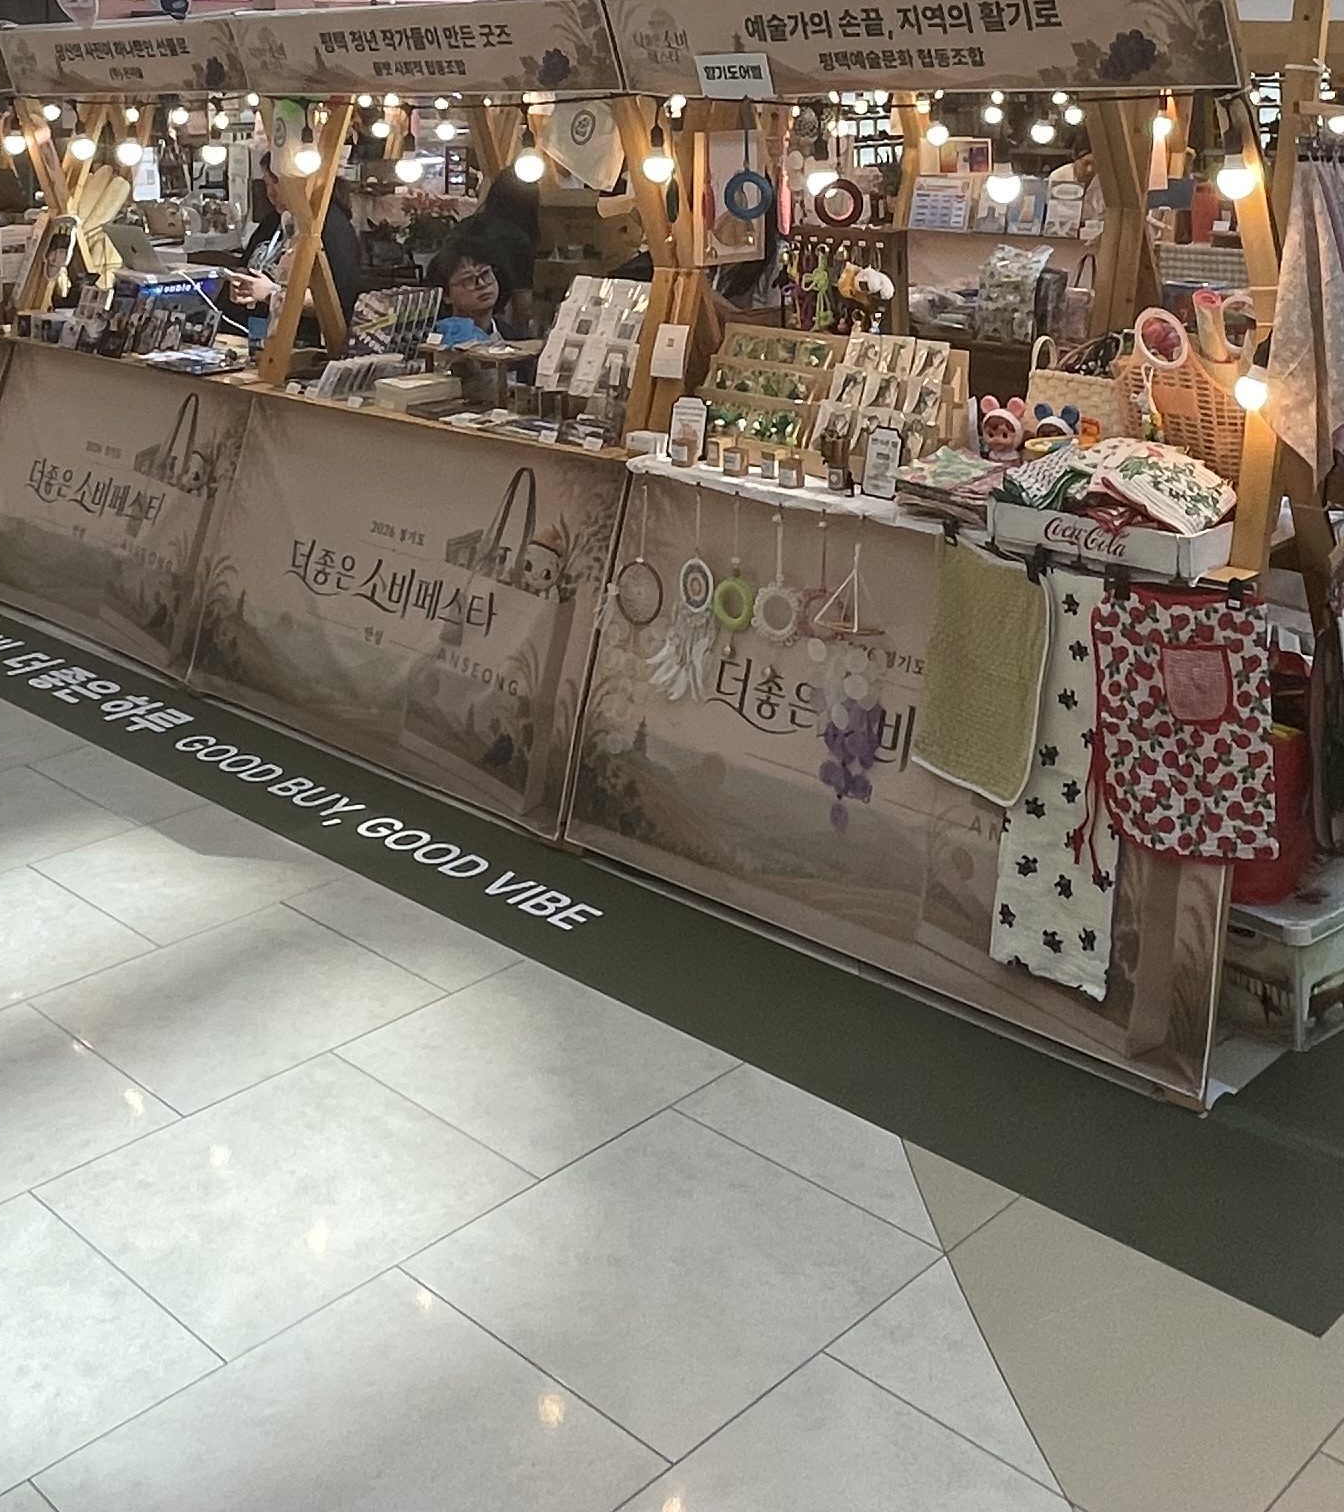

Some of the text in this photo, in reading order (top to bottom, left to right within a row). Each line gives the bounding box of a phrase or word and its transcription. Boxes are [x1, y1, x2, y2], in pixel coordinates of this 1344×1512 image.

[350, 29, 381, 52] 청년
[381, 27, 442, 52] 작가들이
[443, 25, 477, 49] 만든
[478, 24, 514, 47] 굿즈
[744, 9, 833, 44] 예술가의
[838, 3, 895, 42] 손끝,
[899, 0, 975, 34] 지역의
[818, 46, 985, 72] 평택예술문화 협동조합
[173, 734, 284, 784] GOOD
[267, 776, 366, 827] BUY,
[356, 815, 490, 879] GOOD
[485, 869, 603, 931] VIBE
